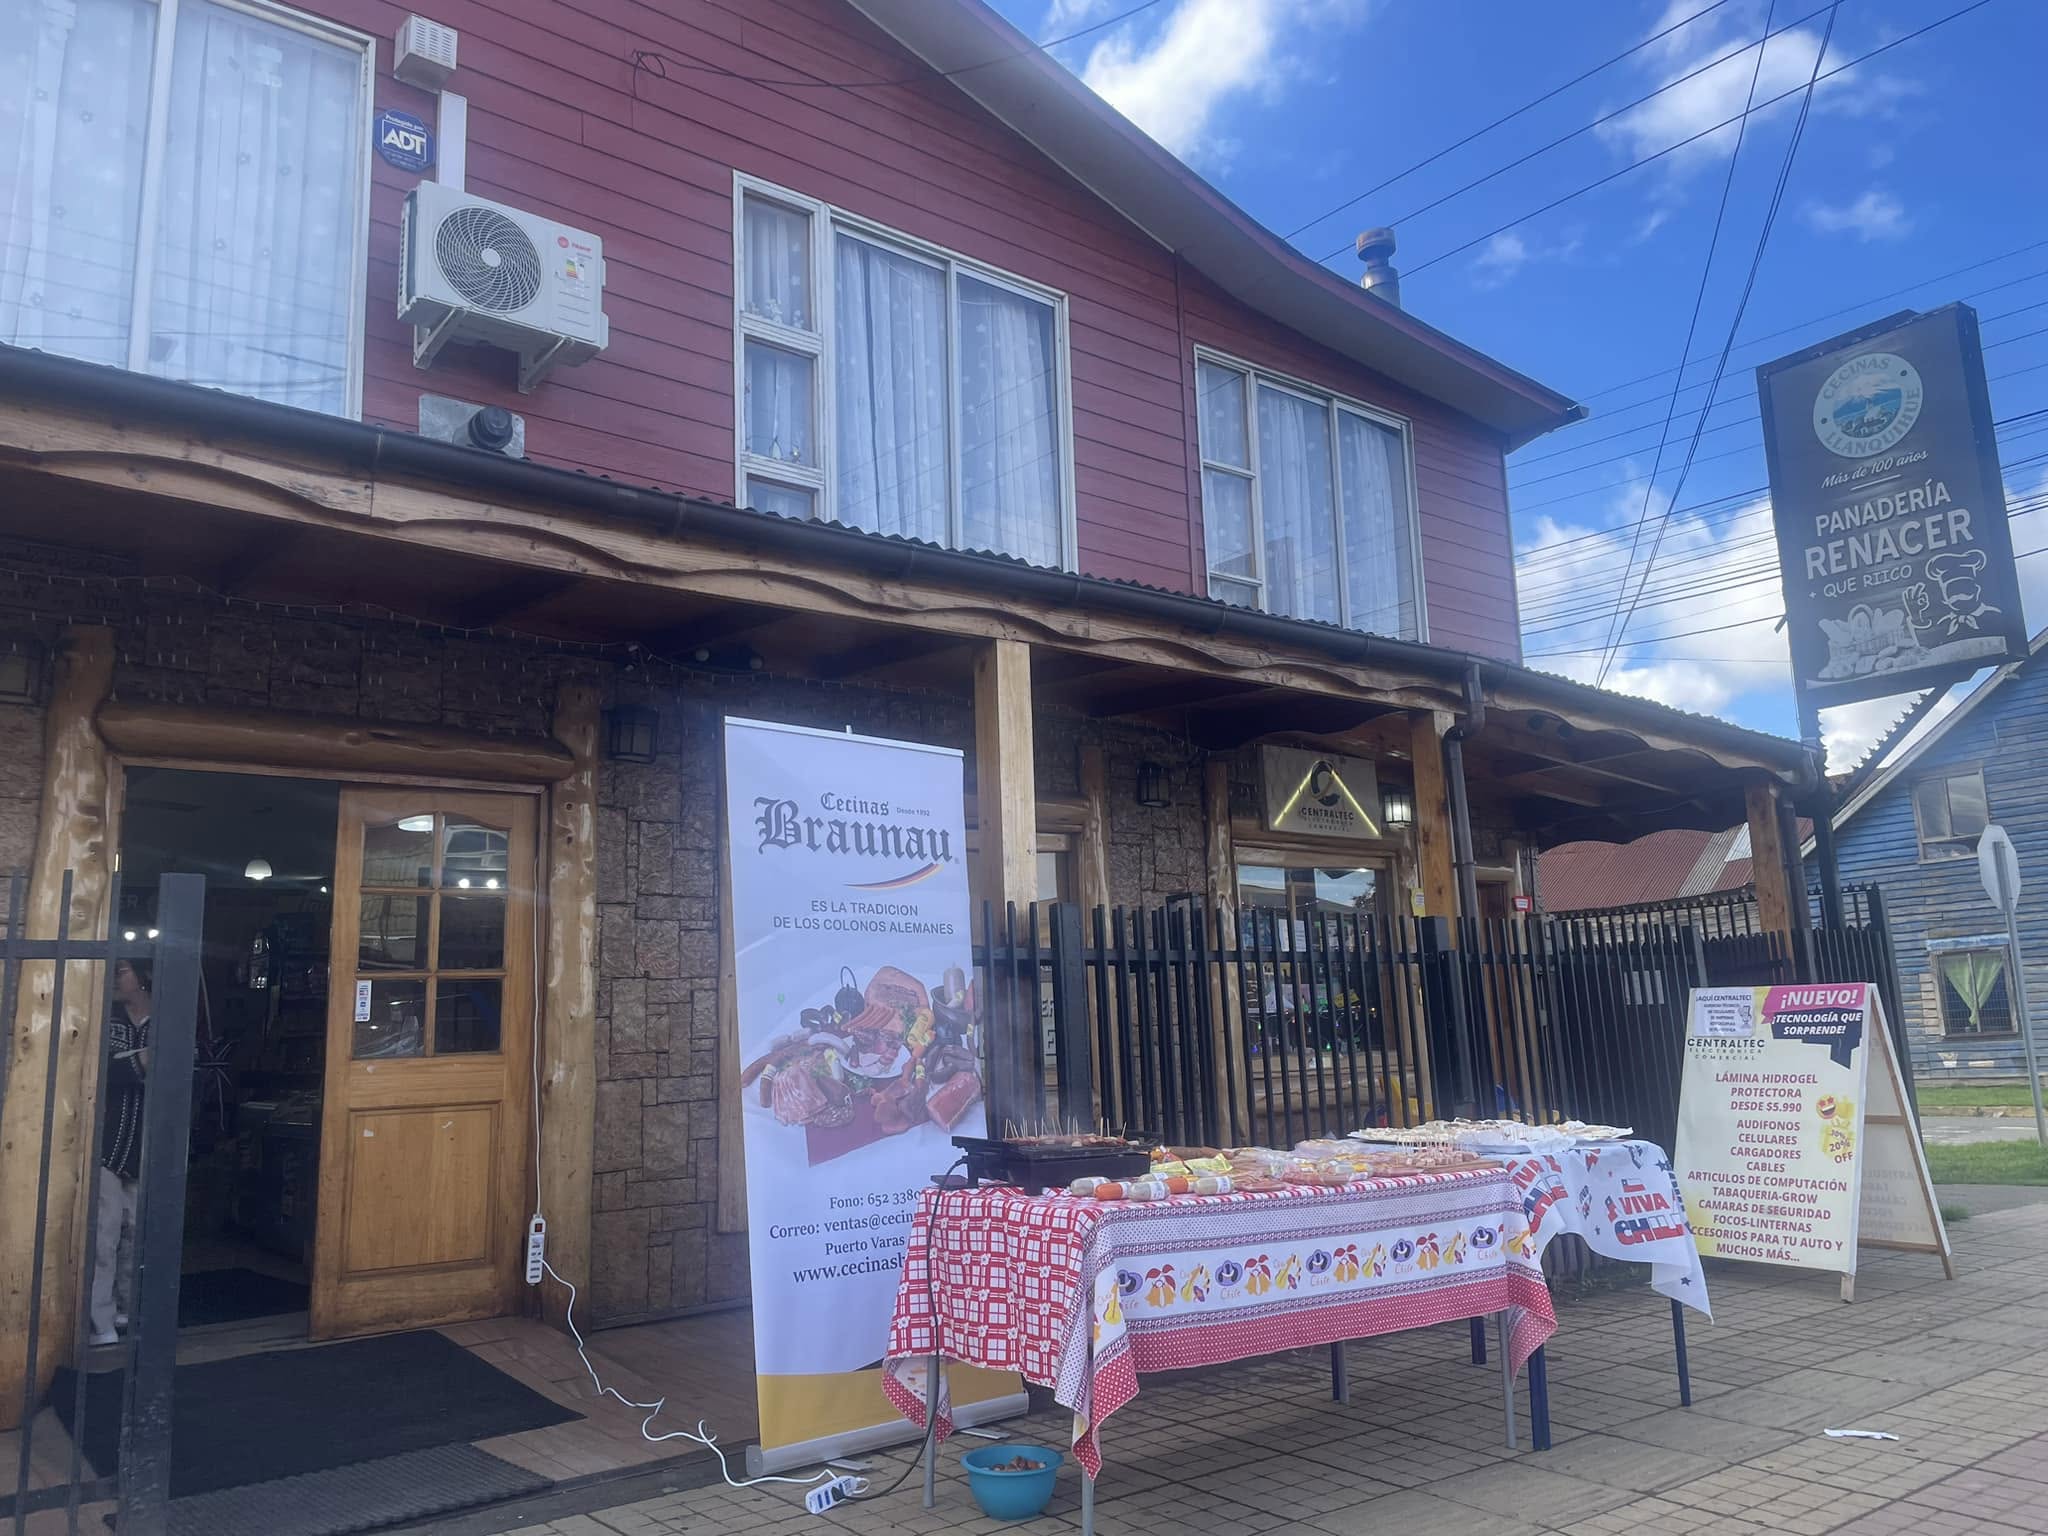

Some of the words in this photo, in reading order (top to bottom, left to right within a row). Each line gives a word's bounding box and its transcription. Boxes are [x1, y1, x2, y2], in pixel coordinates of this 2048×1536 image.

[383, 128, 427, 155] ADT
[1823, 357, 1890, 400] CECINAS
[1823, 387, 1921, 456] LLANQUIHUE
[1820, 472, 1849, 489] Más
[1851, 466, 1867, 480] de
[1871, 457, 1894, 474] 100
[1896, 449, 1929, 467] años
[1815, 478, 1951, 537] PANADERÍA
[1804, 508, 1974, 580] RENACER
[1823, 577, 1857, 598] QUE
[820, 791, 889, 816] Cecinas
[1301, 807, 1355, 821] CENTRALTEC
[753, 796, 953, 863] Braunau
[811, 900, 828, 913] ES
[831, 901, 848, 914] LA
[850, 902, 919, 917] TRADICION
[773, 915, 791, 929] DE
[794, 917, 820, 931] LOS
[823, 918, 887, 933] COLONOS
[889, 921, 954, 936] ALEMANES
[1781, 988, 1859, 1010] ¡NUEVO!
[1771, 1011, 1839, 1025] ¡TECNOLOGÍA
[1840, 1011, 1863, 1024] QUE
[1783, 1025, 1847, 1036] SORPRENDE!
[1687, 1038, 1766, 1049] CENTRALTEC
[1715, 1070, 1759, 1084] LÁMINA
[1762, 1072, 1818, 1084] HIDROGEL
[1730, 1087, 1802, 1099] PROTECTORA
[1730, 1101, 1763, 1112] DESDE
[1766, 1101, 1802, 1113] $5.990
[1738, 1133, 1798, 1146] CELULARES
[1730, 1146, 1802, 1160] CARGADORES
[1834, 1151, 1854, 1164] OFF
[1746, 1161, 1786, 1173] CABLES
[1688, 1170, 1746, 1185] ARTICULOS
[1747, 1175, 1761, 1186] DE
[1763, 1176, 1848, 1192] COMPUTACIÓN
[829, 1196, 864, 1210] Fono:
[867, 1192, 890, 1208] 652
[1618, 1192, 1671, 1216] VIVA
[1712, 1186, 1818, 1204] TABAQUERIA-GROW
[1698, 1199, 1749, 1213] CAMARAS
[1751, 1204, 1764, 1214] DE
[1767, 1204, 1832, 1220] SEGURIDAD
[769, 1223, 820, 1240] Correo:
[1713, 1214, 1813, 1233] FOCOS-LINTERNAS
[825, 1239, 868, 1256] Puerto
[870, 1235, 905, 1250] Varas
[1690, 1225, 1748, 1241] CCESORIOS
[1750, 1231, 1780, 1246] PARA
[1782, 1235, 1798, 1247] TU
[1800, 1237, 1833, 1251] AUTO
[1835, 1240, 1844, 1252] Y
[1715, 1242, 1764, 1258] MUCHOS
[1765, 1247, 1801, 1263] MÁS...
